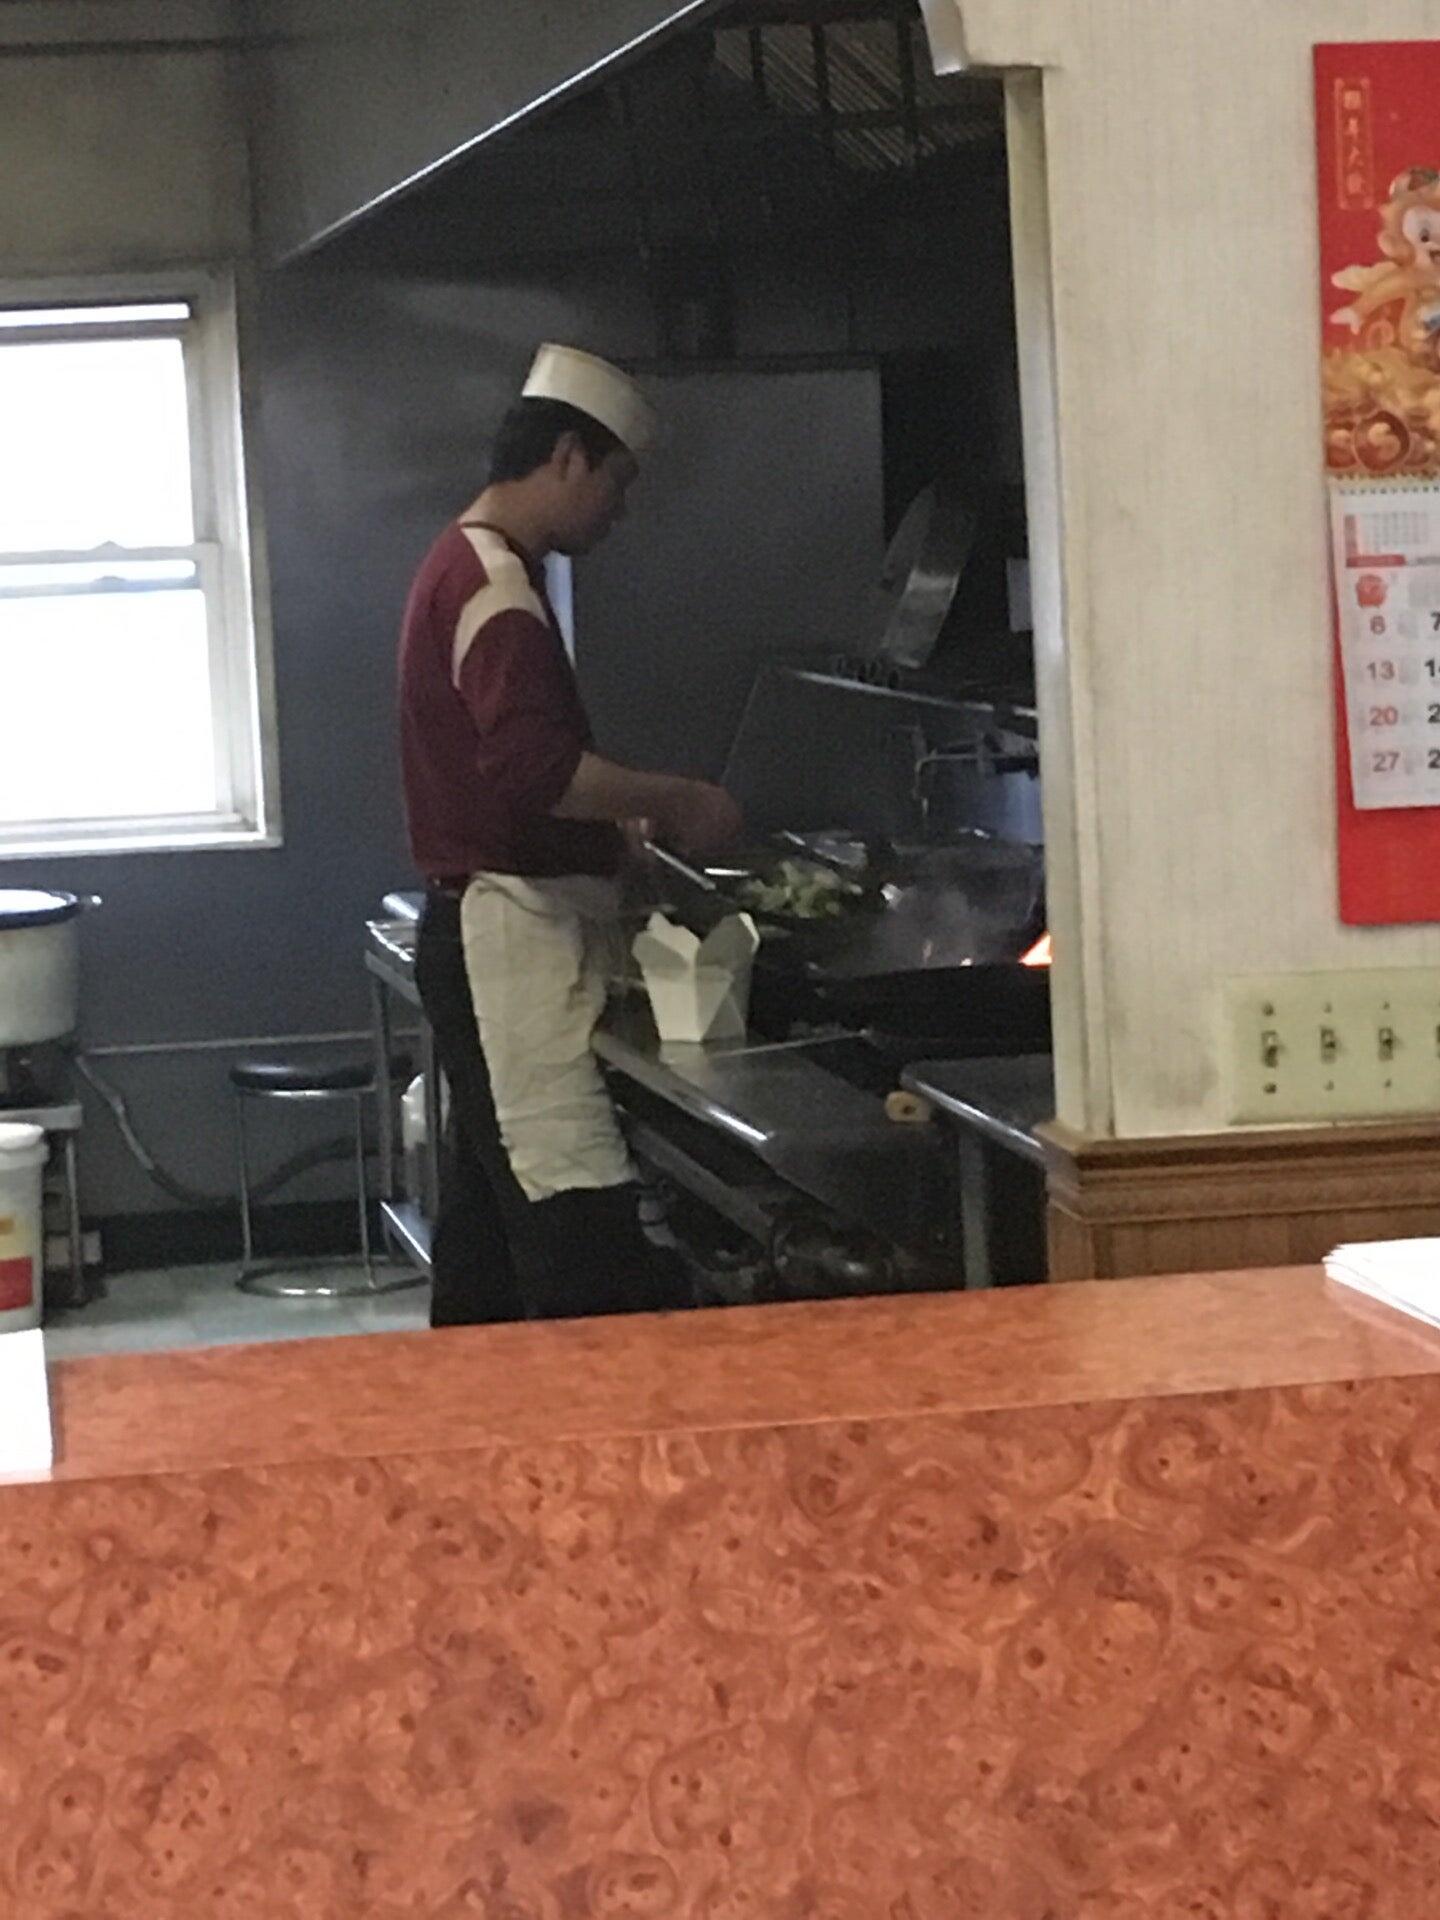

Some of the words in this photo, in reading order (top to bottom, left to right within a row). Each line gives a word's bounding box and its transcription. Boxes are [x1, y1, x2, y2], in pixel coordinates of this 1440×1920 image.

[1370, 615, 1386, 635] 6
[1366, 660, 1396, 681] 13
[1424, 658, 1440, 678] 1
[1369, 705, 1399, 727] 20
[1427, 703, 1440, 724] 2
[1372, 751, 1400, 773] 27
[1427, 748, 1440, 769] 2
